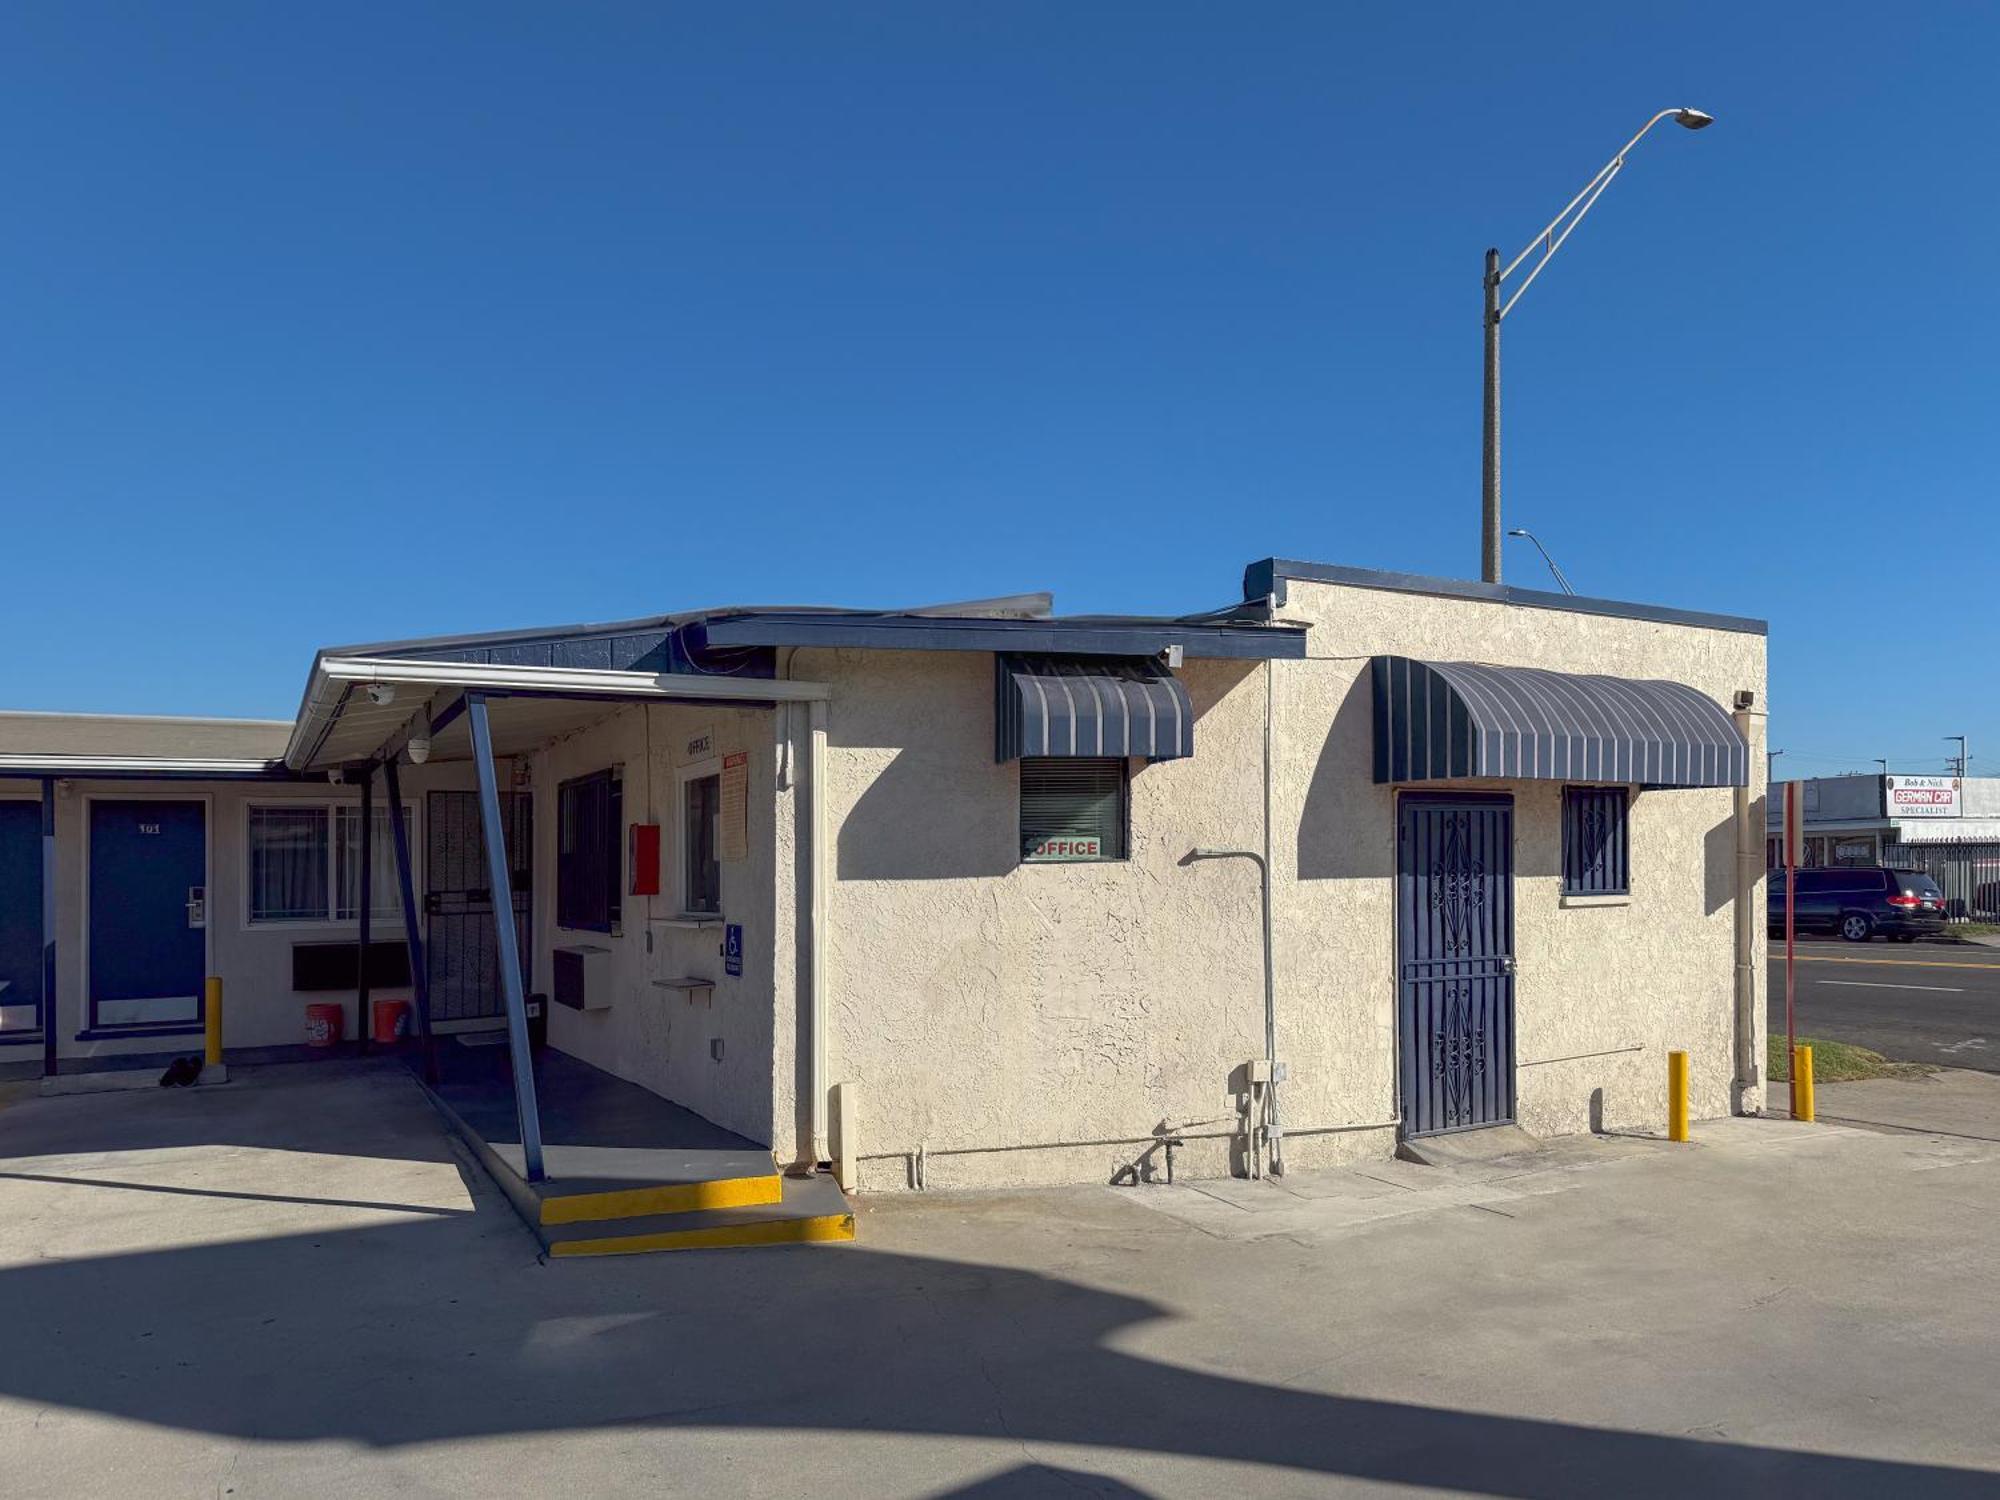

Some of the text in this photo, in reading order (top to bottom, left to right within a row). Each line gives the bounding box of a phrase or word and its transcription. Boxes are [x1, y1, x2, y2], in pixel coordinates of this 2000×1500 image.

[687, 736, 710, 755] OFFICE
[1904, 778, 1918, 786] Bob
[1896, 790, 1951, 803] GERMAN CAR
[1901, 807, 1947, 815] SPECIALIST
[1035, 841, 1097, 855] OFFICE
